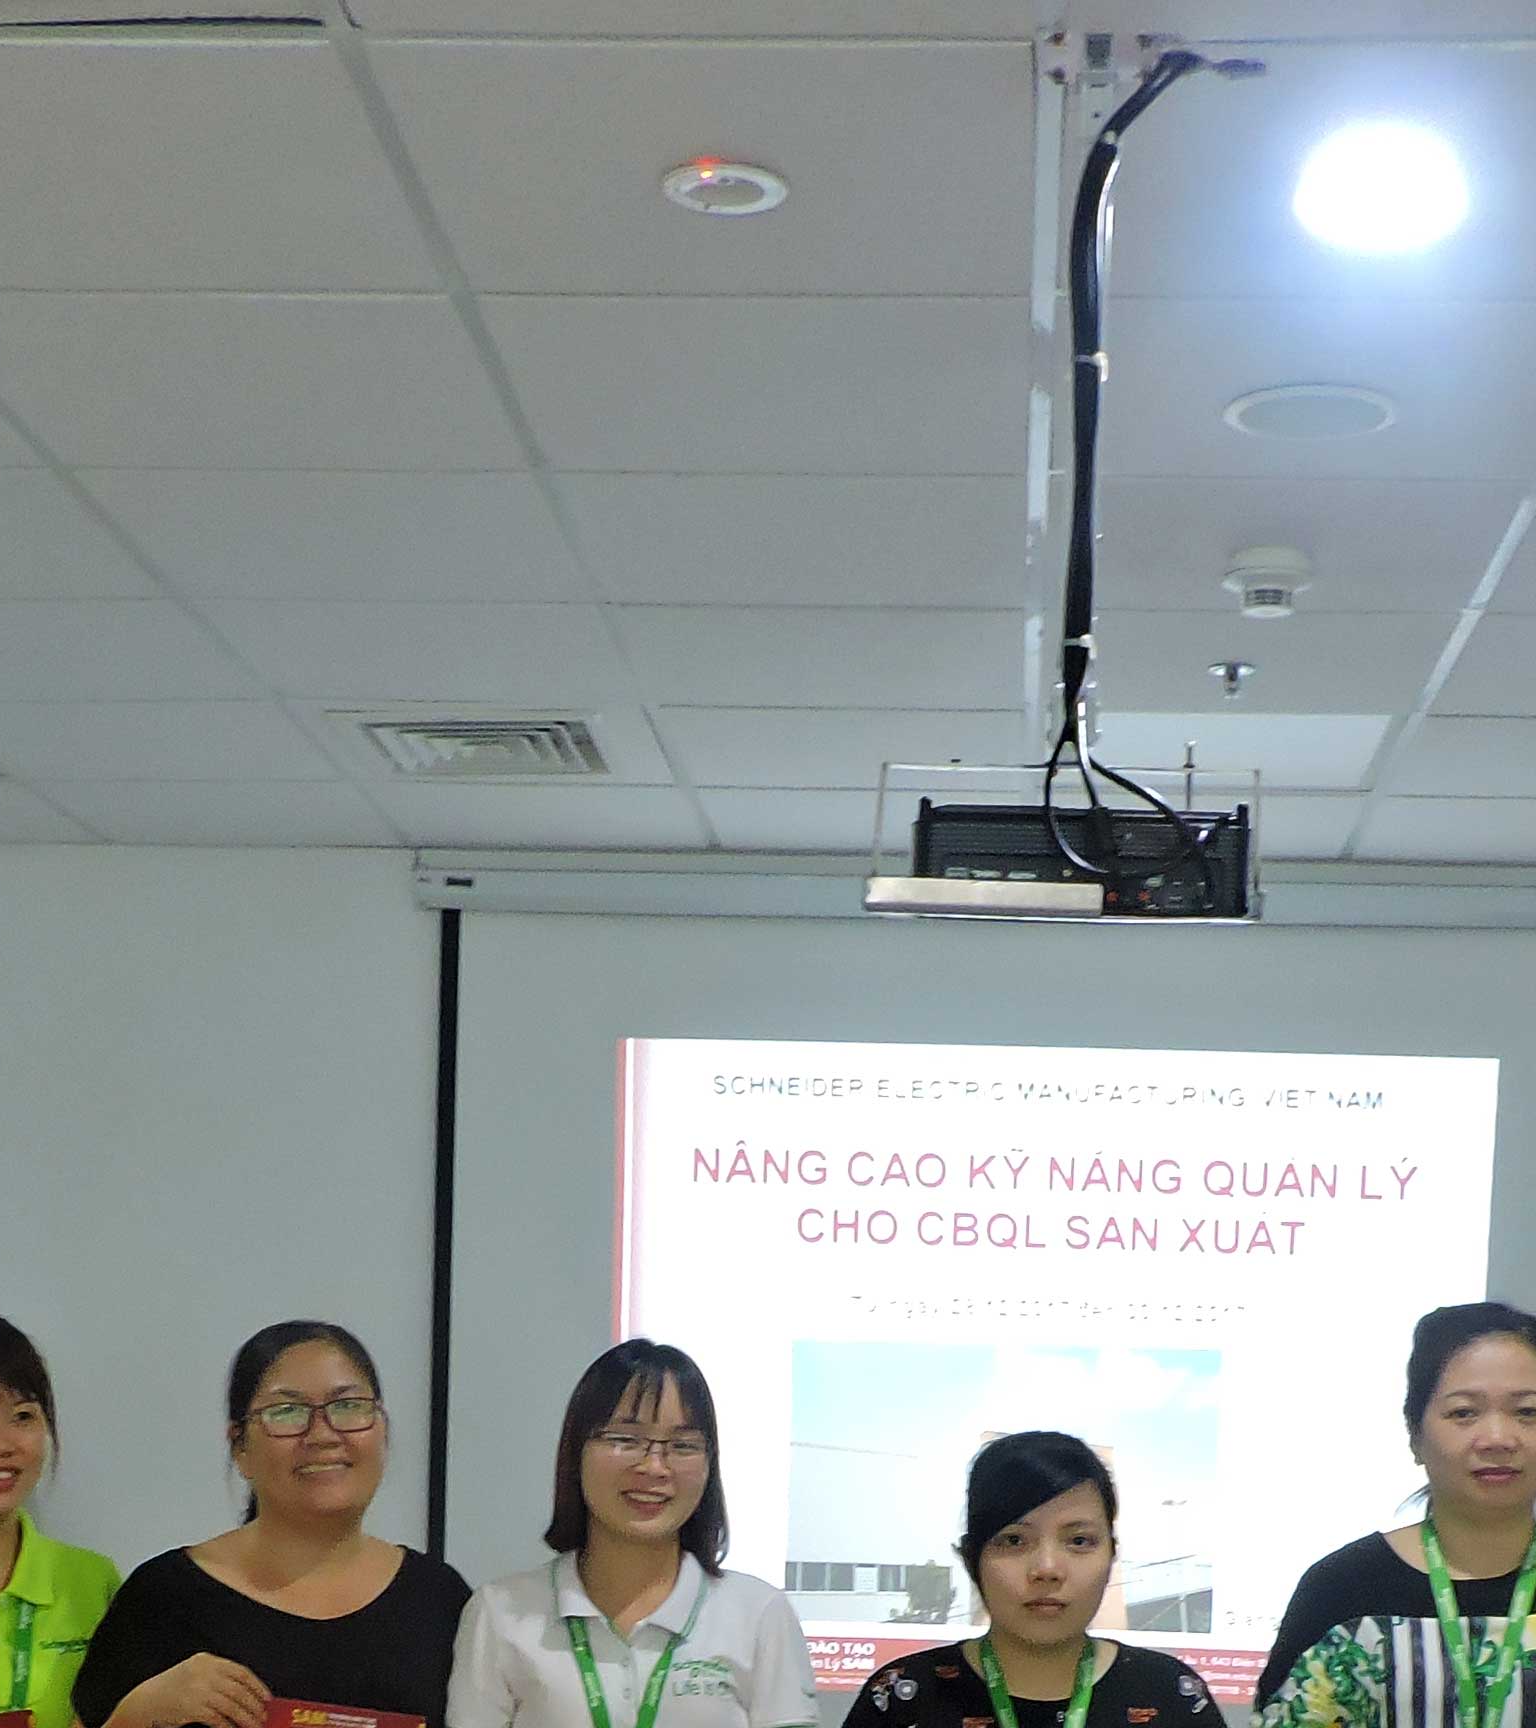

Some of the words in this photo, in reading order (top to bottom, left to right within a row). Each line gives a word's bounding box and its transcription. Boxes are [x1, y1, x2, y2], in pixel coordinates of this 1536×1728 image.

[878, 1080, 1004, 1100] EECRC
[694, 1140, 827, 1185] NÂNG
[848, 1152, 946, 1188] CAO
[1361, 1157, 1418, 1200] LÝ
[798, 1208, 897, 1244] CHO
[918, 1212, 1046, 1249] CBQL
